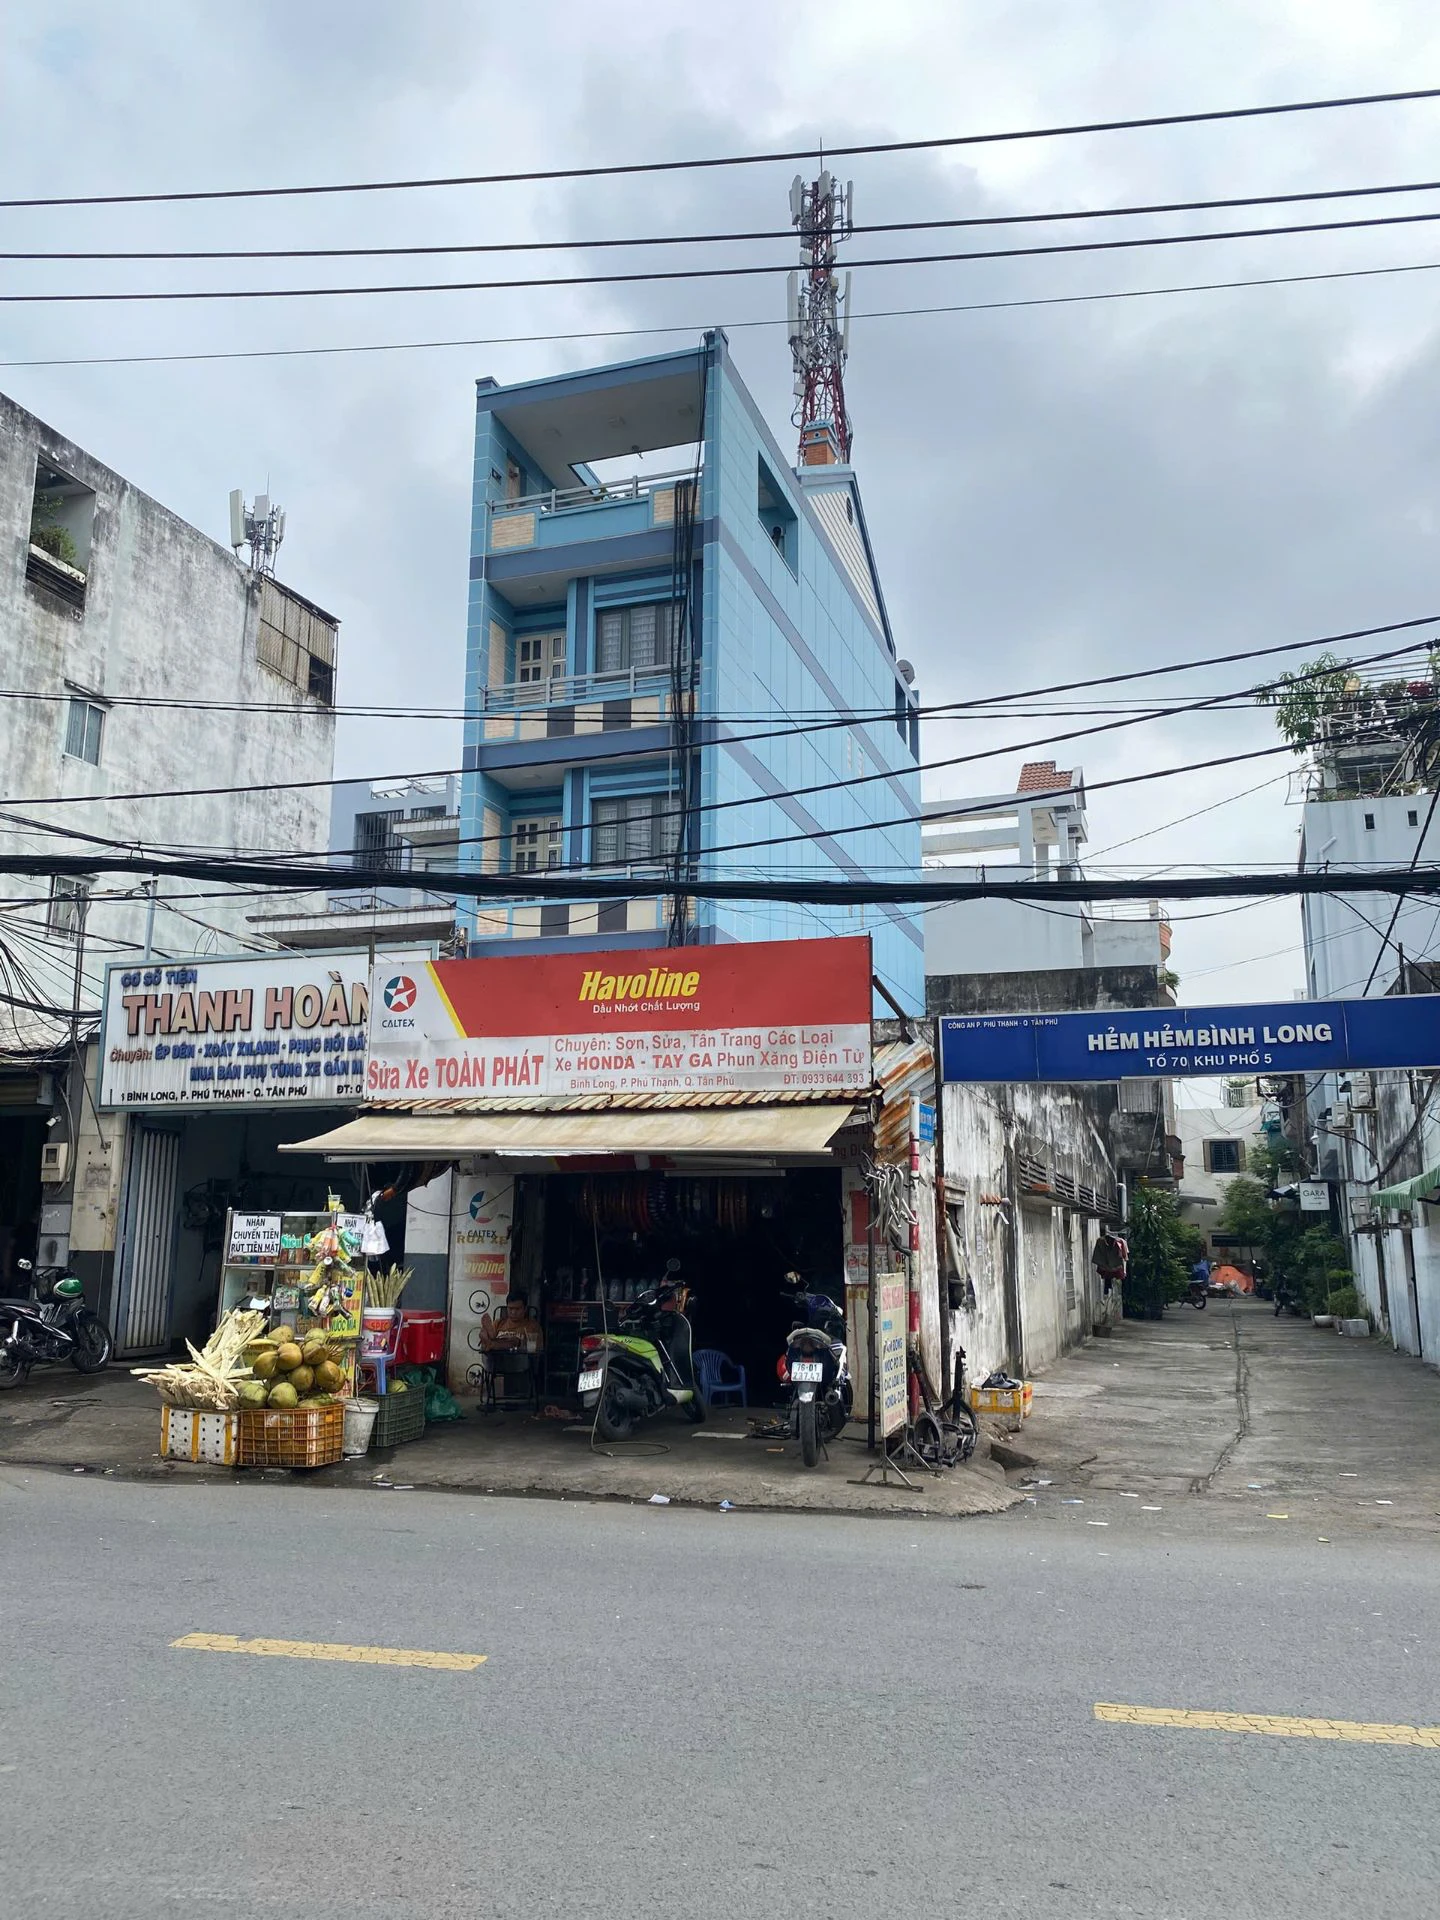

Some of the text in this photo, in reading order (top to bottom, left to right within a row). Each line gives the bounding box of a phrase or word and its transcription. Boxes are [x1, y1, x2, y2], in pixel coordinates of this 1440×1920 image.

[579, 967, 700, 1001] Havoline
[122, 988, 254, 1036] THANH
[666, 1001, 700, 1012] Lượng
[382, 1019, 415, 1028] CALTEX
[947, 1021, 965, 1029] CÔNG
[966, 1021, 975, 1029] AN
[554, 1037, 611, 1055] Chuyên:
[616, 1036, 649, 1051] Sơn,
[721, 1032, 761, 1049] Trang
[768, 1030, 796, 1045] Các
[801, 1029, 833, 1048] Loại
[1088, 1027, 1139, 1051] HẺM
[1262, 1023, 1333, 1044] LONG
[555, 1057, 572, 1071] Xe
[577, 1055, 635, 1071] HONDA
[652, 1054, 684, 1069] TAY
[689, 1053, 713, 1068] GA
[717, 1052, 755, 1067] Phun
[760, 1050, 798, 1068] Xăng
[803, 1050, 837, 1068] Điện
[843, 1048, 865, 1064] Tử
[1171, 1056, 1188, 1067] 70
[1194, 1055, 1225, 1067] KHU
[1229, 1049, 1260, 1065] PHỐ
[1264, 1053, 1272, 1064] 5
[304, 1061, 321, 1077] XE
[368, 1049, 544, 1089] Sửa Xe TOÀN PHÁT
[620, 1078, 628, 1088] P.
[697, 1075, 714, 1087] Tân
[716, 1075, 735, 1086] Phú
[783, 1073, 799, 1085] ĐT:
[802, 1073, 825, 1084] 0933
[827, 1073, 844, 1084] 644
[127, 1090, 149, 1102] BÌNH
[151, 1091, 178, 1102] LONG,
[180, 1090, 189, 1100] P.
[191, 1088, 210, 1100] PHÚ
[212, 1088, 245, 1100] THẠNH
[254, 1087, 264, 1097] Q.
[266, 1085, 286, 1097] TÂN
[288, 1084, 308, 1097] PHÚ
[336, 1084, 353, 1095] ĐT:
[467, 1230, 497, 1239] CALTEX
